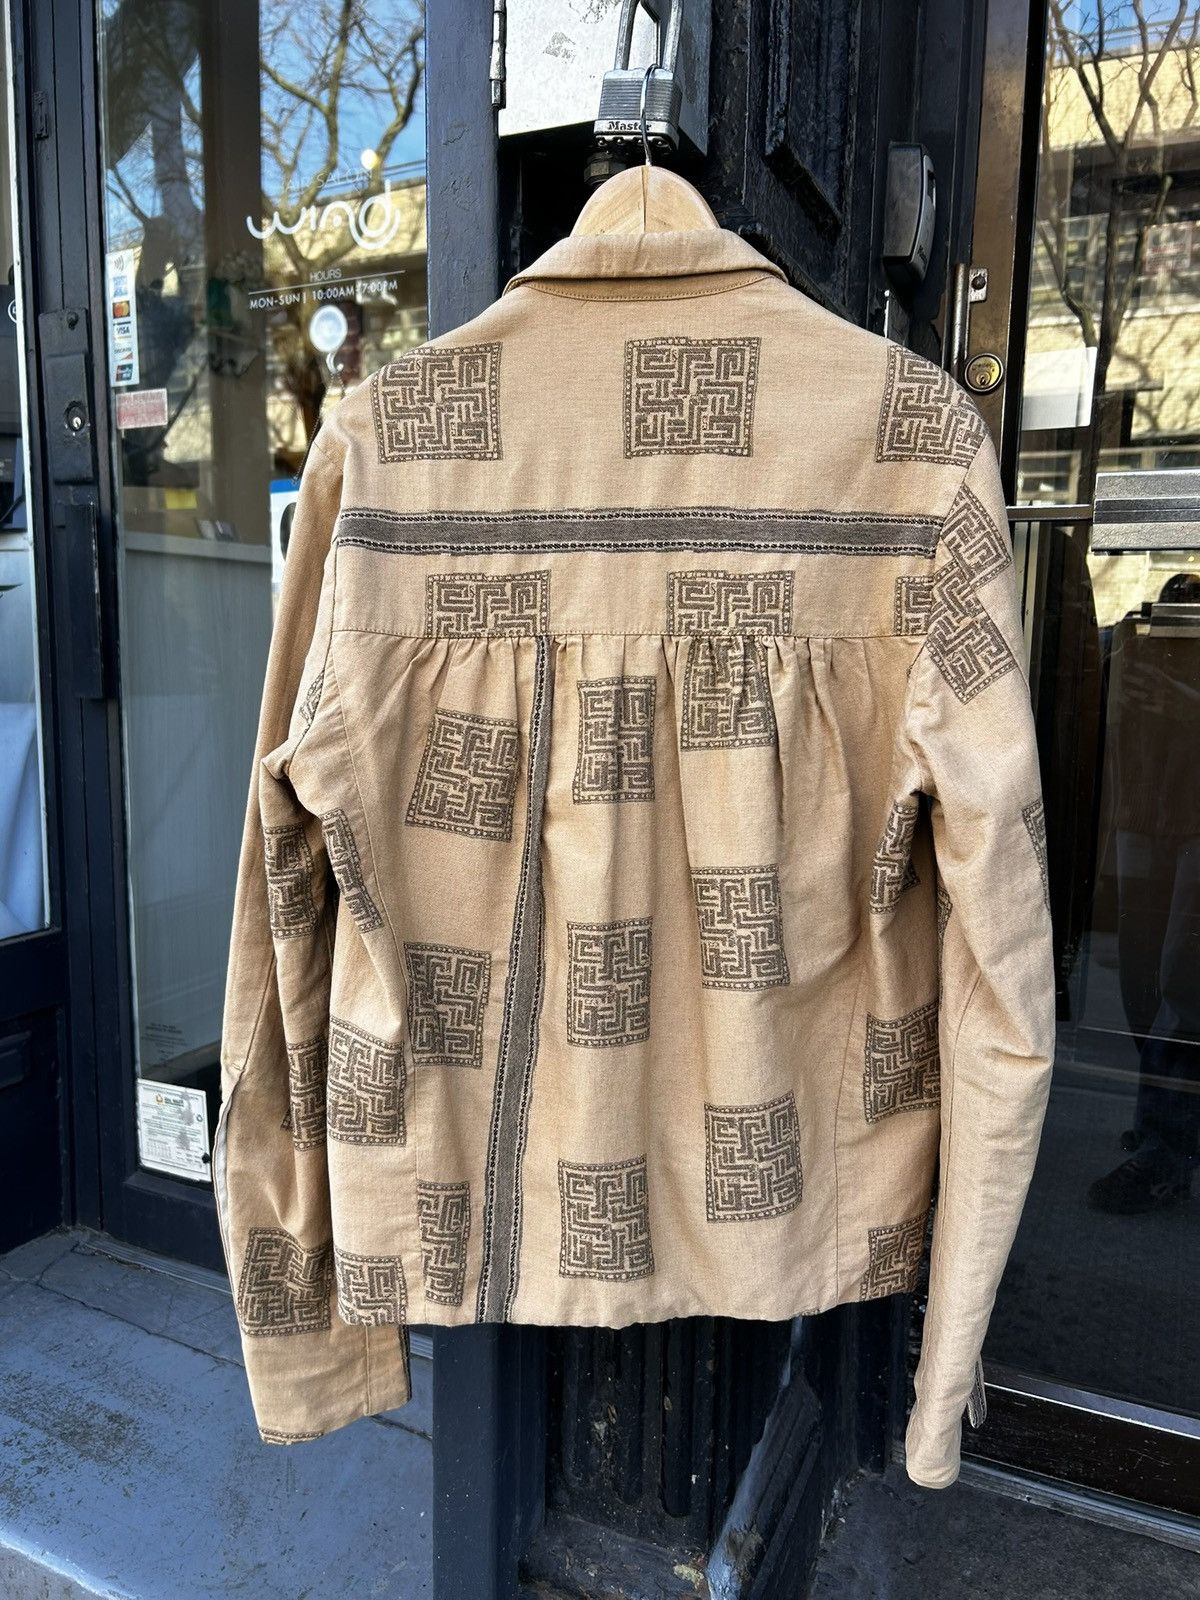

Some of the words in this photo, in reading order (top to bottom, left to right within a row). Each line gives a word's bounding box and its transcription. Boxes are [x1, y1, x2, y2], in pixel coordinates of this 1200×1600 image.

[608, 121, 652, 131] Mastr
[310, 268, 342, 282] HOURS
[250, 292, 300, 310] MON-SUN
